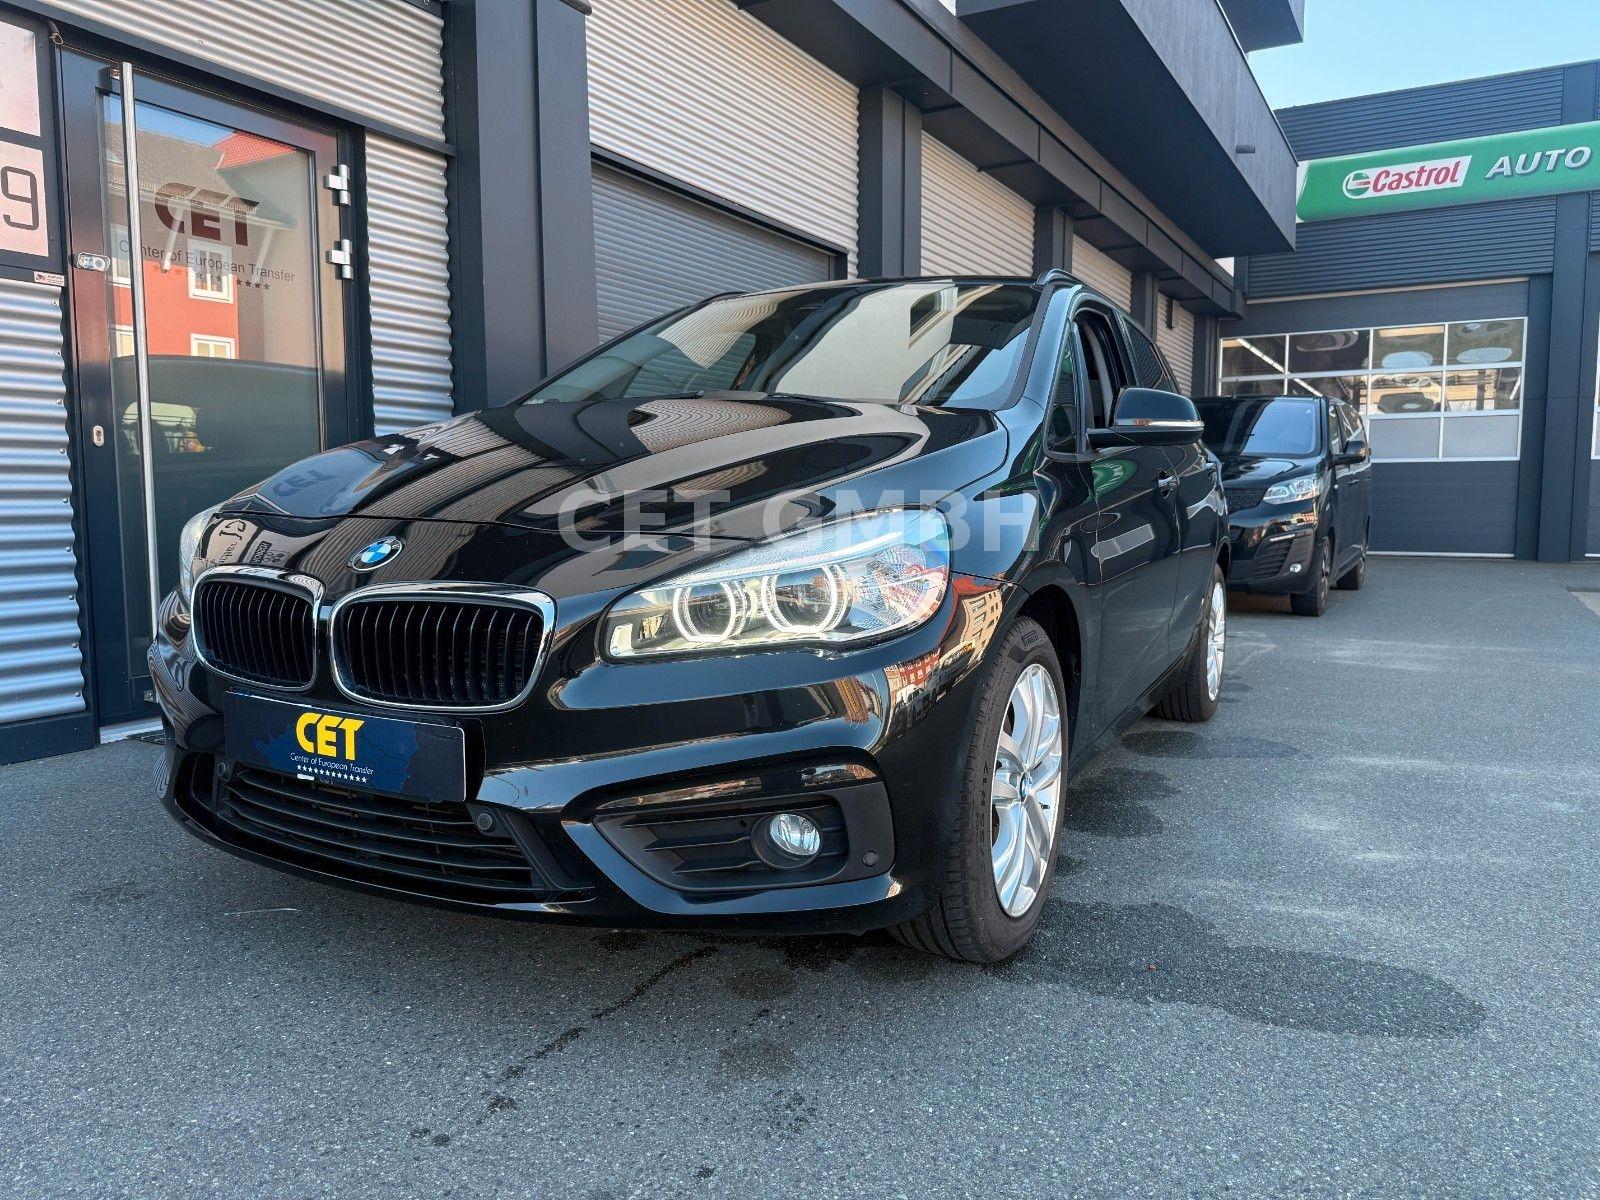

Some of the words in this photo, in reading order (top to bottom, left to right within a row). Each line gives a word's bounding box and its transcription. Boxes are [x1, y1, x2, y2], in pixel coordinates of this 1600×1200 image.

[1372, 160, 1461, 193] Castrol
[1484, 146, 1592, 180] AUTO
[1, 165, 40, 231] 9
[155, 183, 260, 247] CET
[119, 240, 164, 259] Cnter
[170, 250, 182, 262] of
[186, 251, 246, 274] European
[249, 263, 297, 282] Transfer
[296, 712, 365, 760] CET
[290, 752, 309, 763] Center
[310, 757, 318, 765] of
[318, 757, 348, 771] European
[349, 763, 374, 775] Transfer
